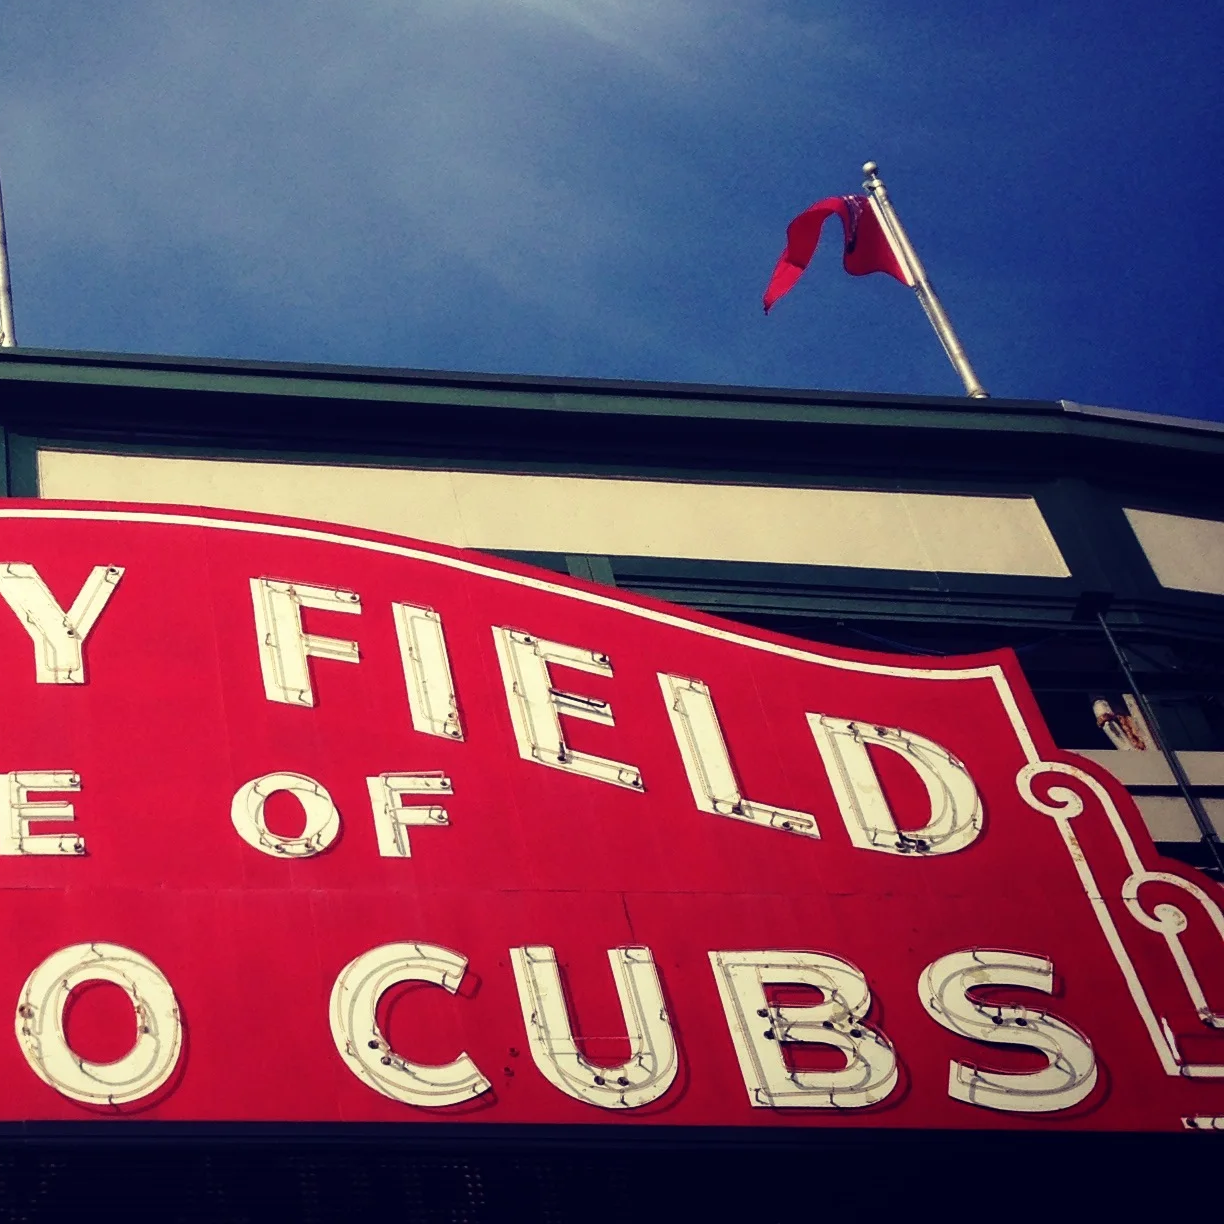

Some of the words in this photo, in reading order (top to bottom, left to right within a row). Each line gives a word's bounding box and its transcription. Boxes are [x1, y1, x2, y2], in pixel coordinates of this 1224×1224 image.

[249, 577, 984, 857] FIELD
[231, 771, 453, 857] OF
[329, 942, 1098, 1112] CUBS
